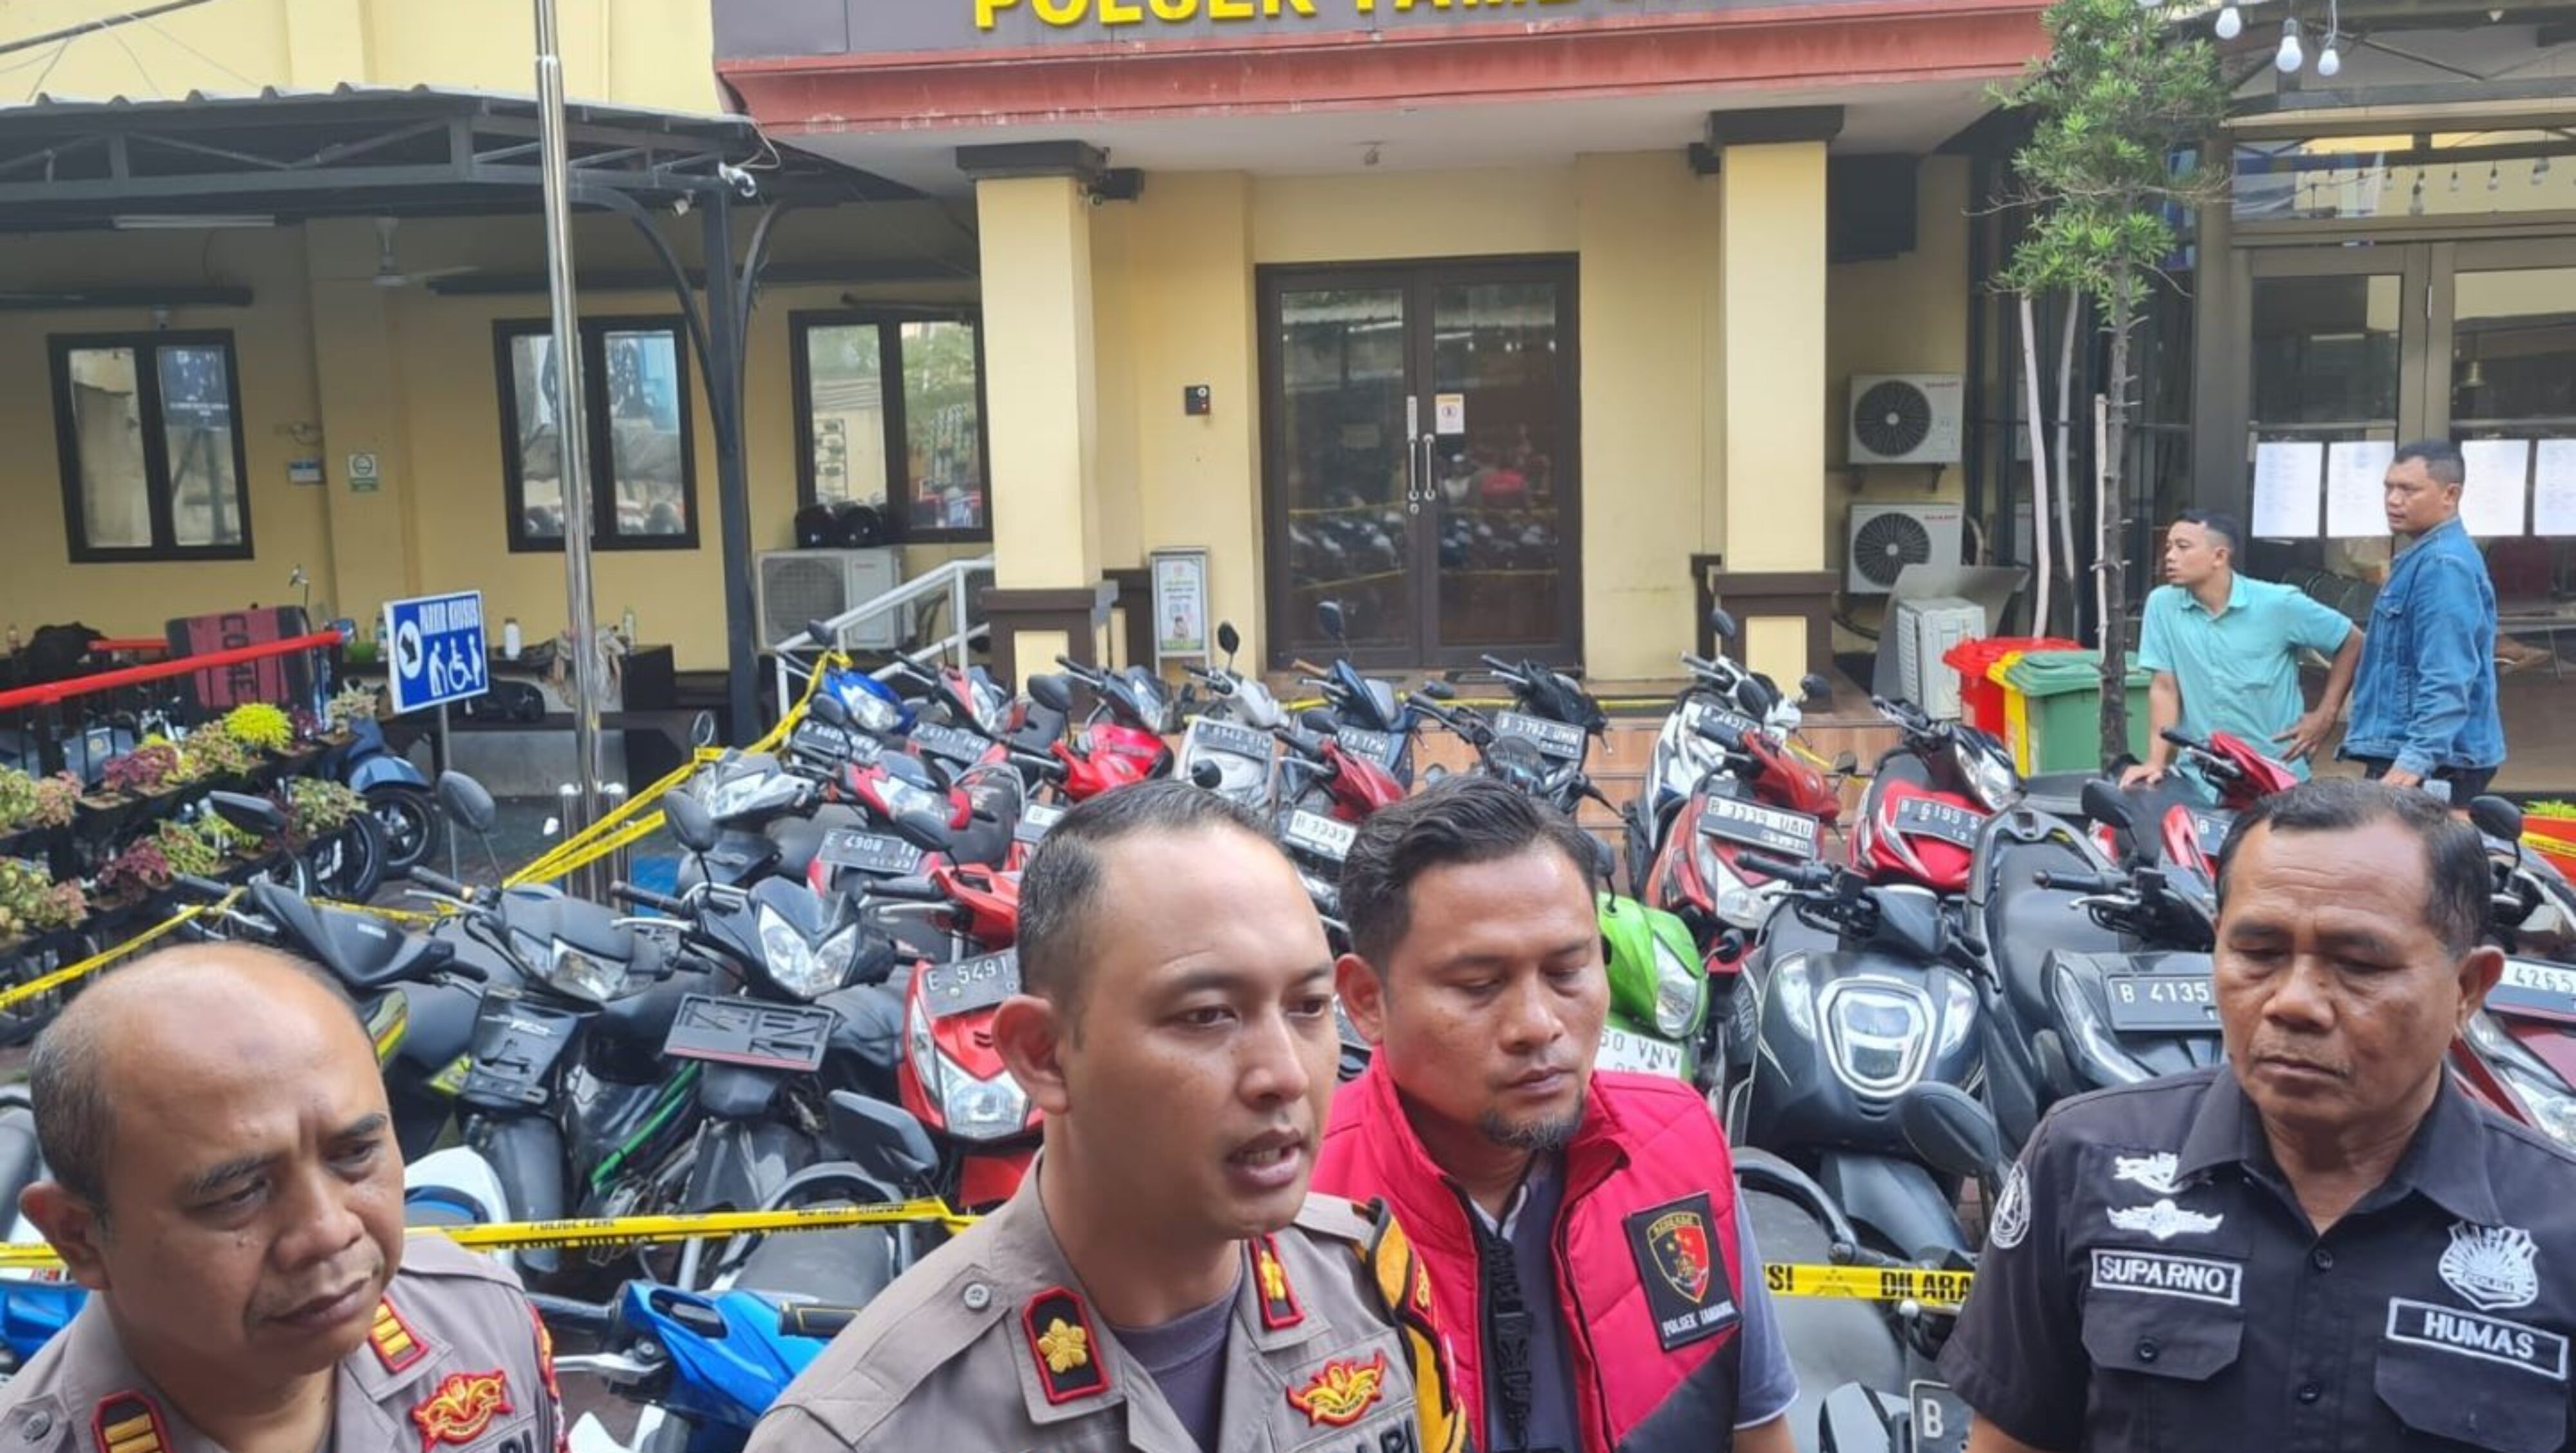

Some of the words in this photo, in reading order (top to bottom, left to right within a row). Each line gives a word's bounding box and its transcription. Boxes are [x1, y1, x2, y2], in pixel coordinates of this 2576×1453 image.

[927, 971, 938, 990] E
[2119, 983, 2135, 1003] B
[2149, 981, 2210, 1003] 4135
[2099, 1255, 2227, 1293] SUPARNO
[2423, 1311, 2535, 1360] HUMAS
[1922, 1398, 1944, 1438] B
